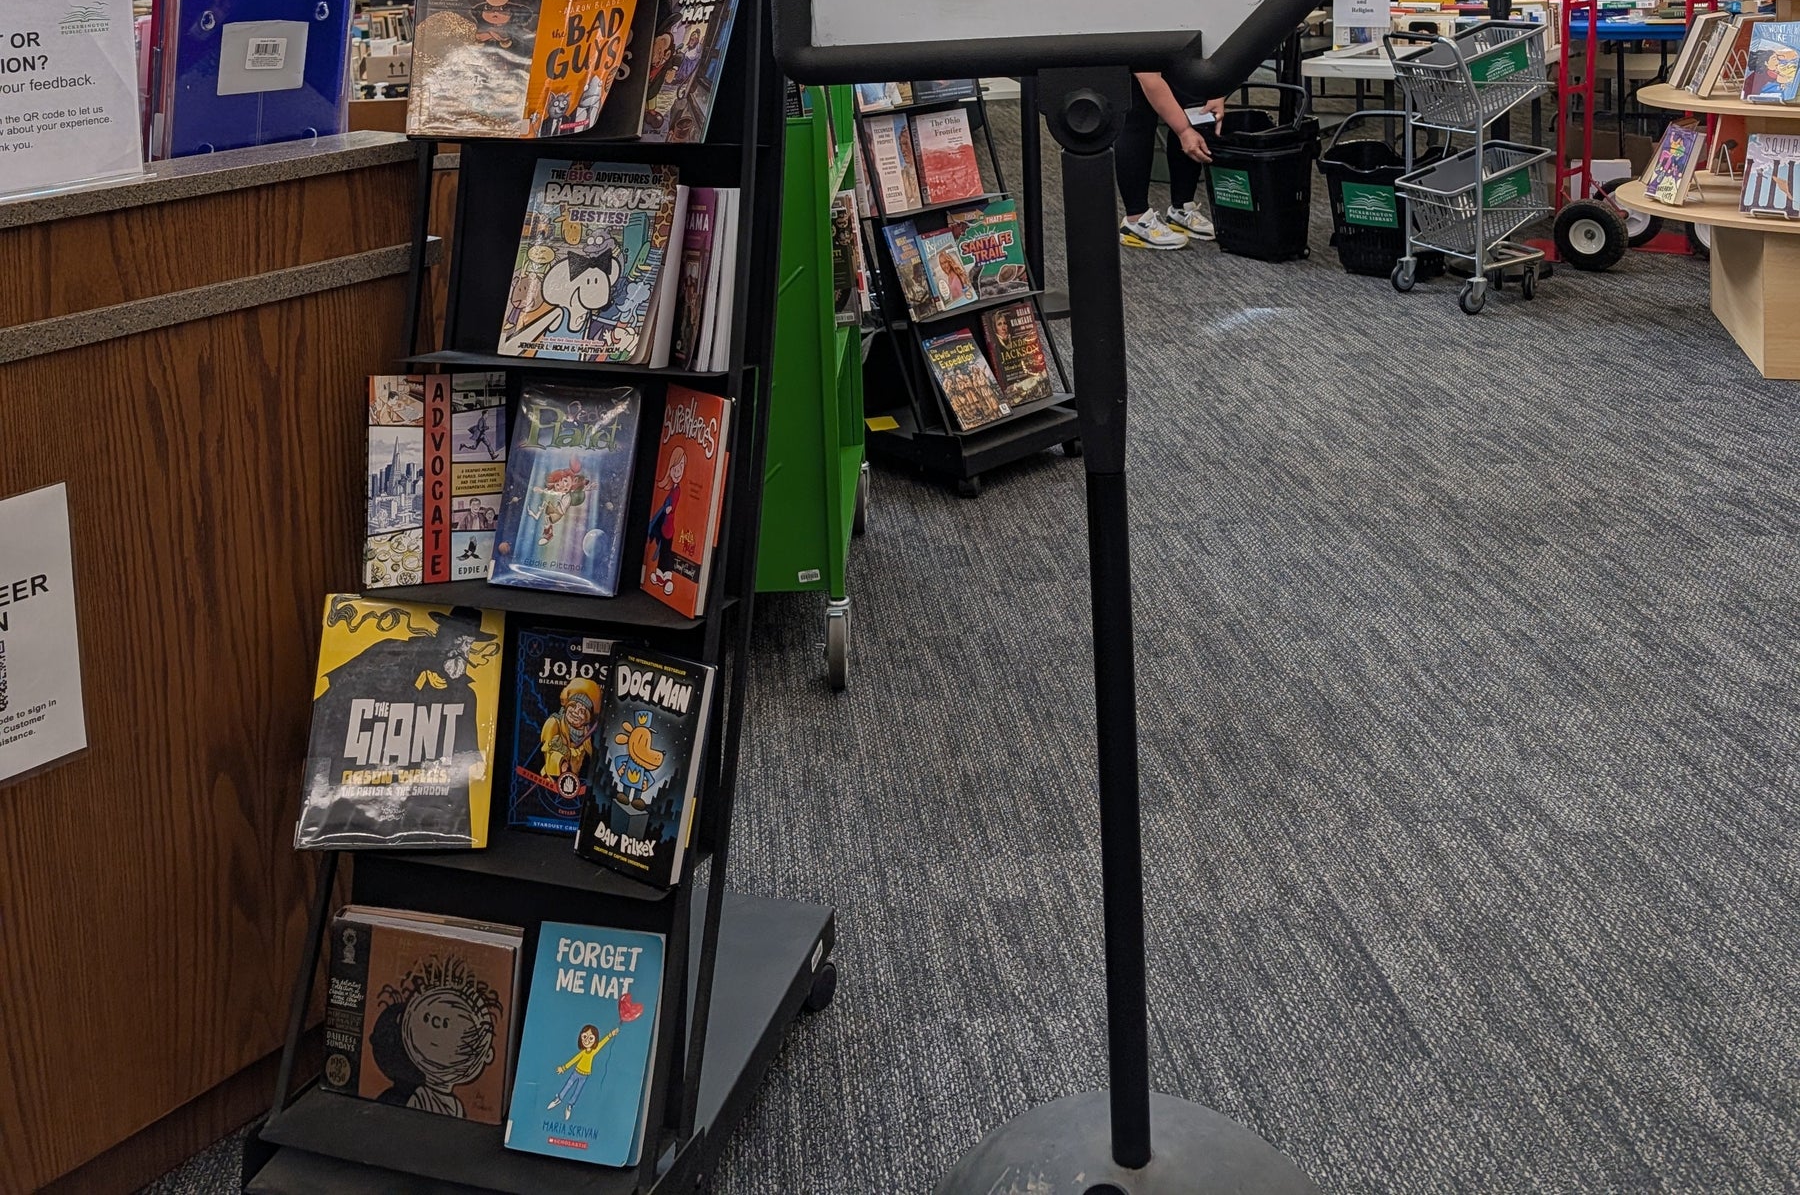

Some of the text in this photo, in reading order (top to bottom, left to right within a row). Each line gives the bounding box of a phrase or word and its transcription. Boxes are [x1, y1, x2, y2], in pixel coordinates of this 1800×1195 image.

[681, 5, 715, 22] HAT
[552, 7, 625, 47] the BAD
[10, 31, 41, 49] OR
[545, 37, 621, 81] GUYS
[30, 73, 96, 91] feedback.
[5, 105, 104, 125] the QR code to let us
[931, 116, 961, 127] The Ohio
[6, 116, 113, 136] about your experience.
[934, 126, 962, 137] Frontier
[13, 141, 33, 153] you.
[1765, 137, 1799, 154] SQUIR
[551, 169, 663, 184] THE BIG ADVENTURES OF
[545, 182, 664, 211] BABYMOUSE
[1216, 191, 1249, 201] PICKERINGTON
[1217, 195, 1249, 205] PUBLIC LIBRARY
[570, 209, 630, 224] BESTIES!
[1349, 209, 1393, 217] PICKERINGTON
[1369, 215, 1393, 223] LIBRARY
[961, 235, 996, 255] SANTA
[997, 232, 1013, 245] FE
[974, 247, 1007, 262] TRAIL
[552, 344, 570, 352] HOLM
[604, 346, 620, 354] HOLM
[930, 343, 976, 362] Lewis Clark
[1001, 344, 1040, 364] JACKSON
[939, 353, 976, 369] Expedition
[430, 382, 445, 576] ADVOCATE
[458, 566, 481, 575] EDDIE
[570, 644, 582, 652] 04
[617, 665, 692, 714] DOG MAN
[28, 703, 47, 714] sign
[48, 699, 57, 707] in
[375, 701, 390, 718] THE
[3, 714, 45, 734] Customer
[342, 770, 393, 785] ORSON
[356, 786, 385, 797] ARTIST
[412, 786, 450, 797] SHADOW
[533, 821, 563, 830] STARDUST
[594, 821, 618, 847] DAV
[556, 937, 643, 972] FORGET
[556, 968, 634, 1000] ME NAT
[542, 1120, 599, 1140] MARIA SCRIVAN
